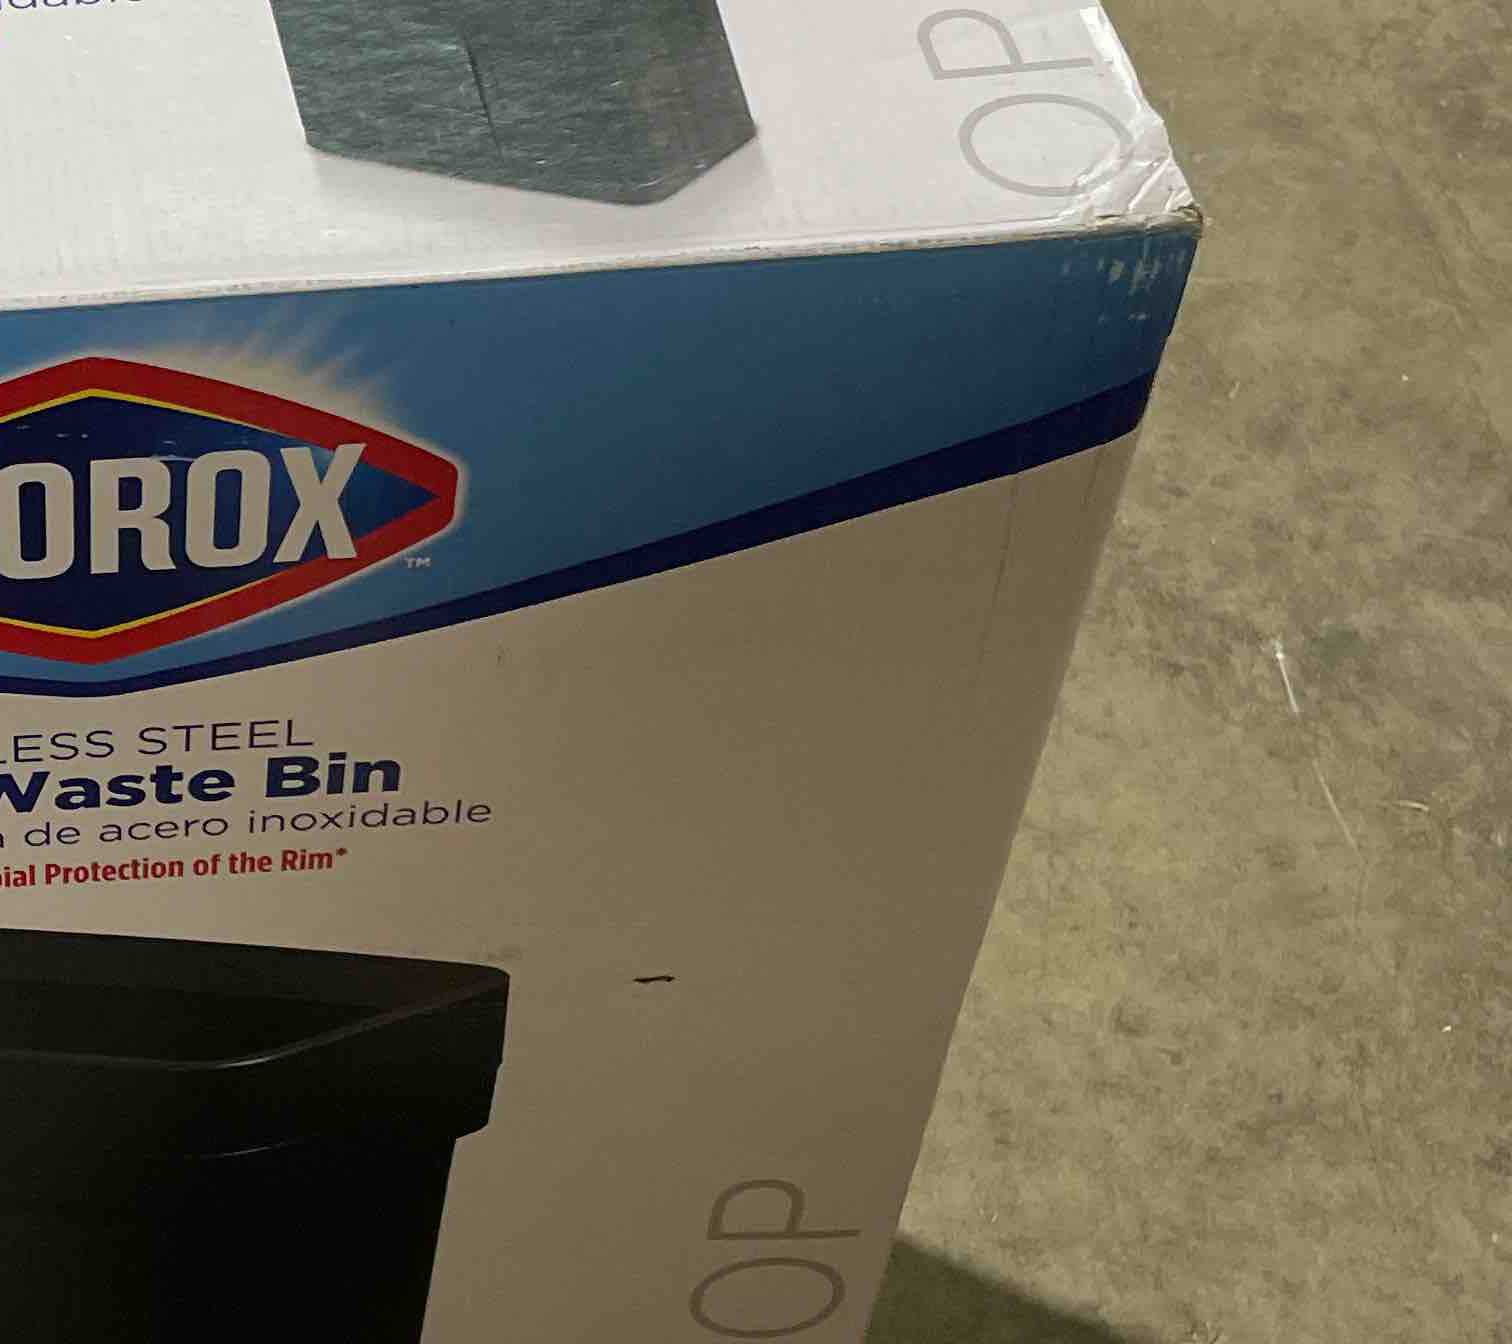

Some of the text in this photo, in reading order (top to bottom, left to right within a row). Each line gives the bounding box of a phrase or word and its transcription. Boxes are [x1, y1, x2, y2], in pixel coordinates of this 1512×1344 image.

[137, 719, 314, 755] STEEL
[264, 752, 401, 799] Bin
[24, 820, 80, 849] de
[99, 813, 228, 842] acero
[249, 799, 493, 834] inoxidable
[43, 854, 187, 887] Protection
[193, 851, 222, 875] of
[228, 849, 272, 873] the
